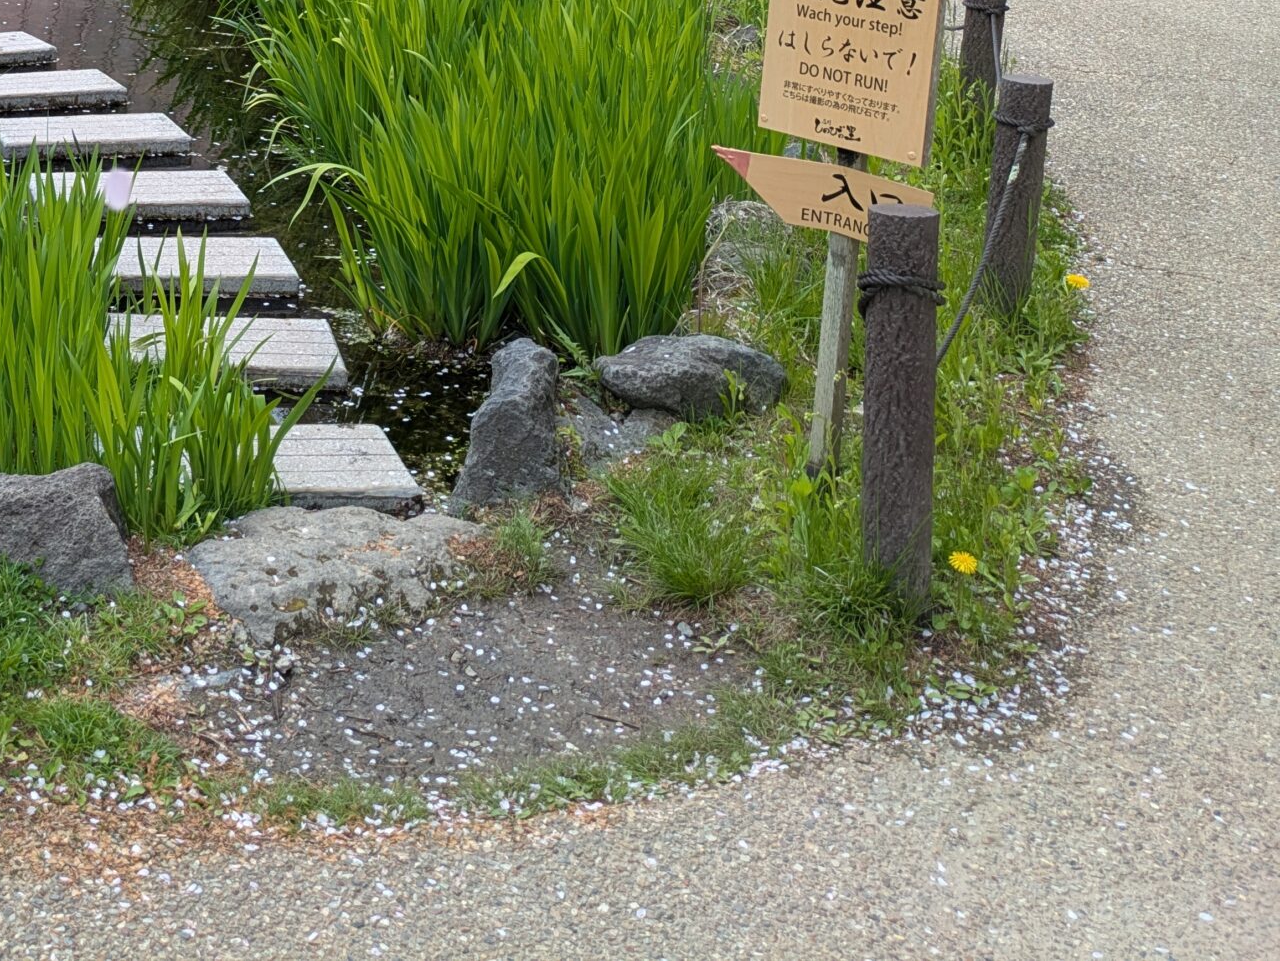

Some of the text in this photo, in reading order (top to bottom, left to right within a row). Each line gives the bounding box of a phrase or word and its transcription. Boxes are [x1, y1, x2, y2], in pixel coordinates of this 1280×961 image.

[796, 3, 903, 37] Wach your step!
[778, 30, 917, 76] はしらないで！
[799, 61, 888, 93] DO NOT RUN!
[782, 90, 890, 121] こちらは撮影の為の飛び石です。
[783, 80, 900, 114] 非常にすべりやすくなっております。
[801, 208, 869, 235] ENTRANC
